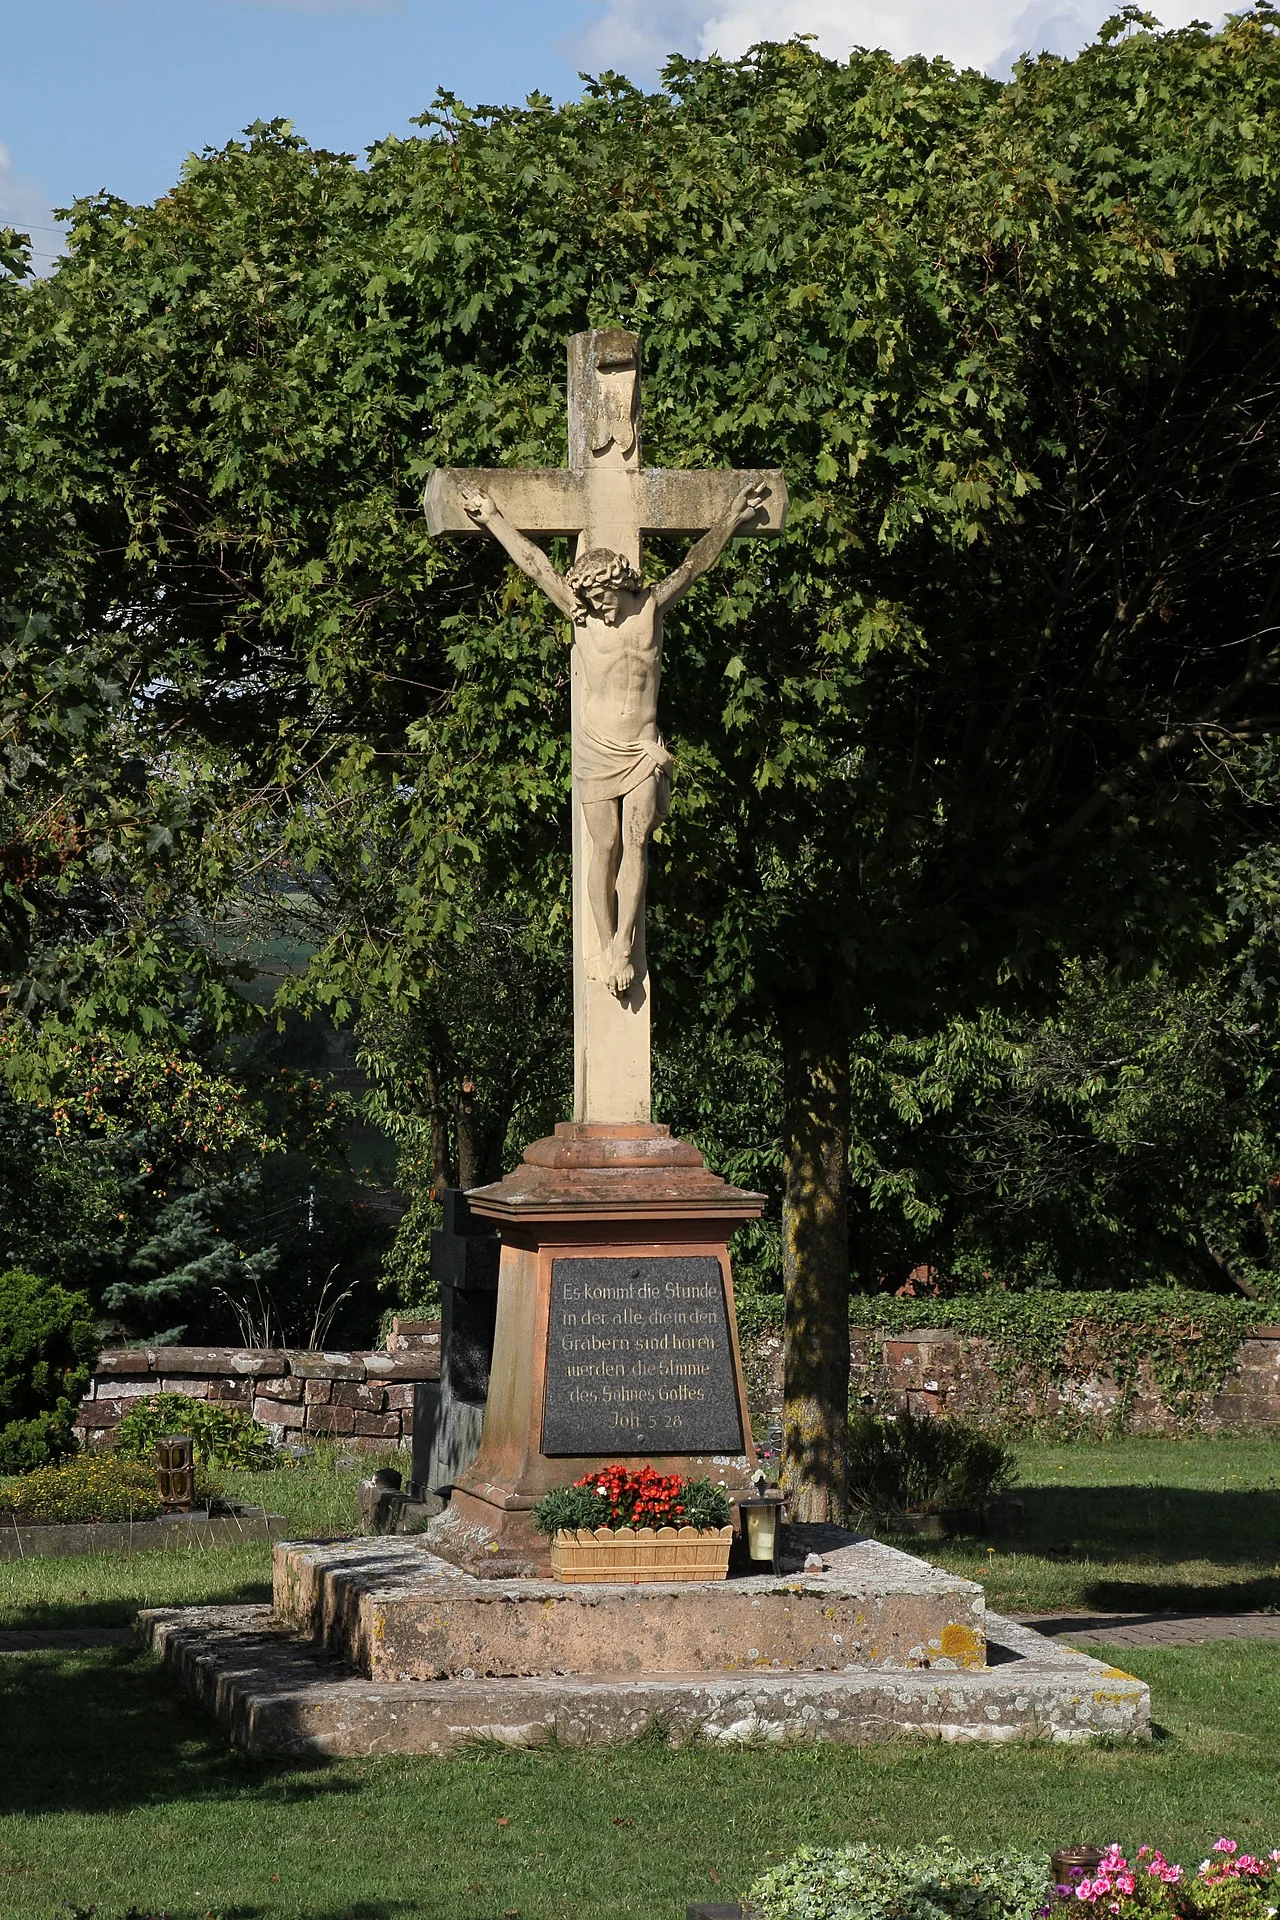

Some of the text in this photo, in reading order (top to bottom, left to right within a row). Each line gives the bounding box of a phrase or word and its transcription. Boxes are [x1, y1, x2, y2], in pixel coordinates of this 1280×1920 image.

[563, 1283, 582, 1300] Es
[584, 1283, 636, 1300] kommt
[637, 1283, 660, 1300] die
[563, 1312, 578, 1326] in
[581, 1310, 608, 1326] der
[650, 1308, 673, 1325] die
[674, 1311, 687, 1325] in
[690, 1307, 718, 1324] den
[635, 1334, 669, 1351] sind
[567, 1358, 710, 1377] werden die Stimme
[570, 1384, 705, 1402] des Sohnes Gottes
[664, 1414, 683, 1428] 28
